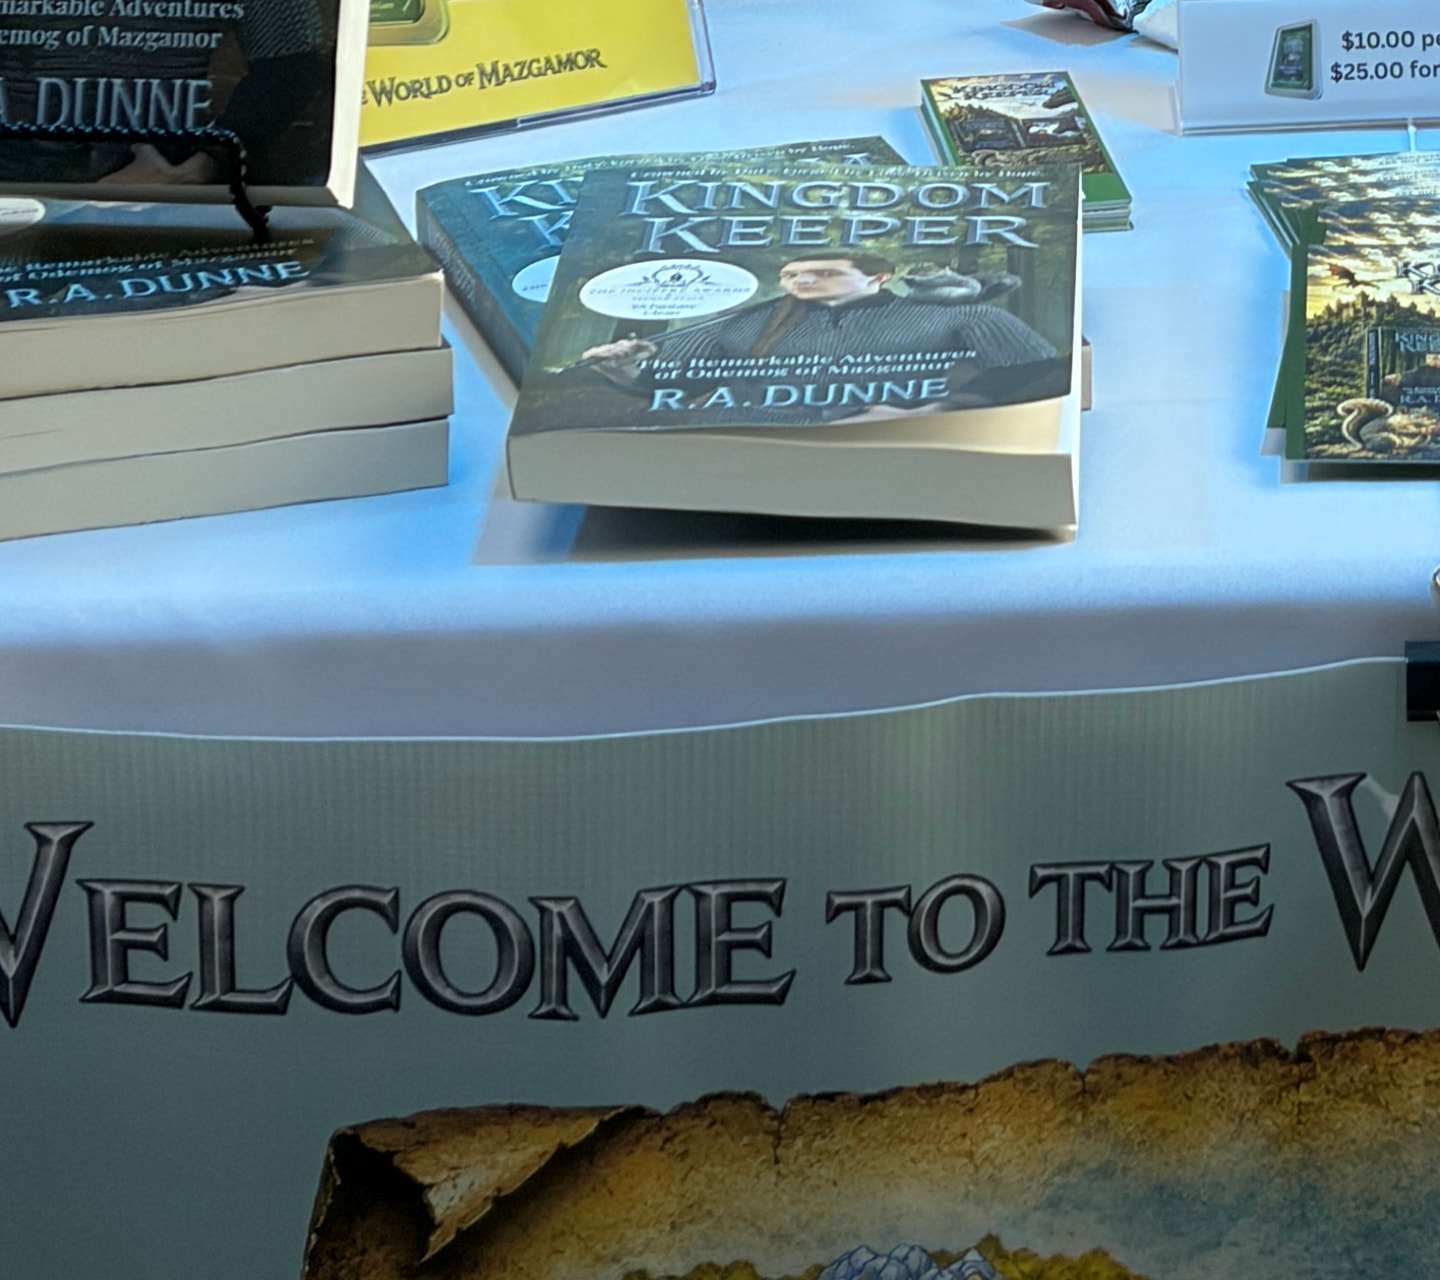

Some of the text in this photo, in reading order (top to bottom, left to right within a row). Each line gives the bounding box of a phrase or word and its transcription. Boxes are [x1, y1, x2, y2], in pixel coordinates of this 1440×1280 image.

[98, 25, 222, 49] Mazgamor
[1342, 30, 1414, 51] $10.00
[368, 48, 607, 108] WORLD OF MAZGAMOR
[1330, 62, 1403, 83] $25.00
[1410, 59, 1440, 78] for
[36, 77, 215, 130] DUNNE
[623, 181, 1050, 217] KINGDOM
[643, 216, 1039, 253] KEEPER
[4, 261, 311, 308] R.A. DUNNE
[650, 378, 951, 412] R.A. DUNNE
[825, 874, 1002, 987] TO
[1028, 844, 1275, 957] THE
